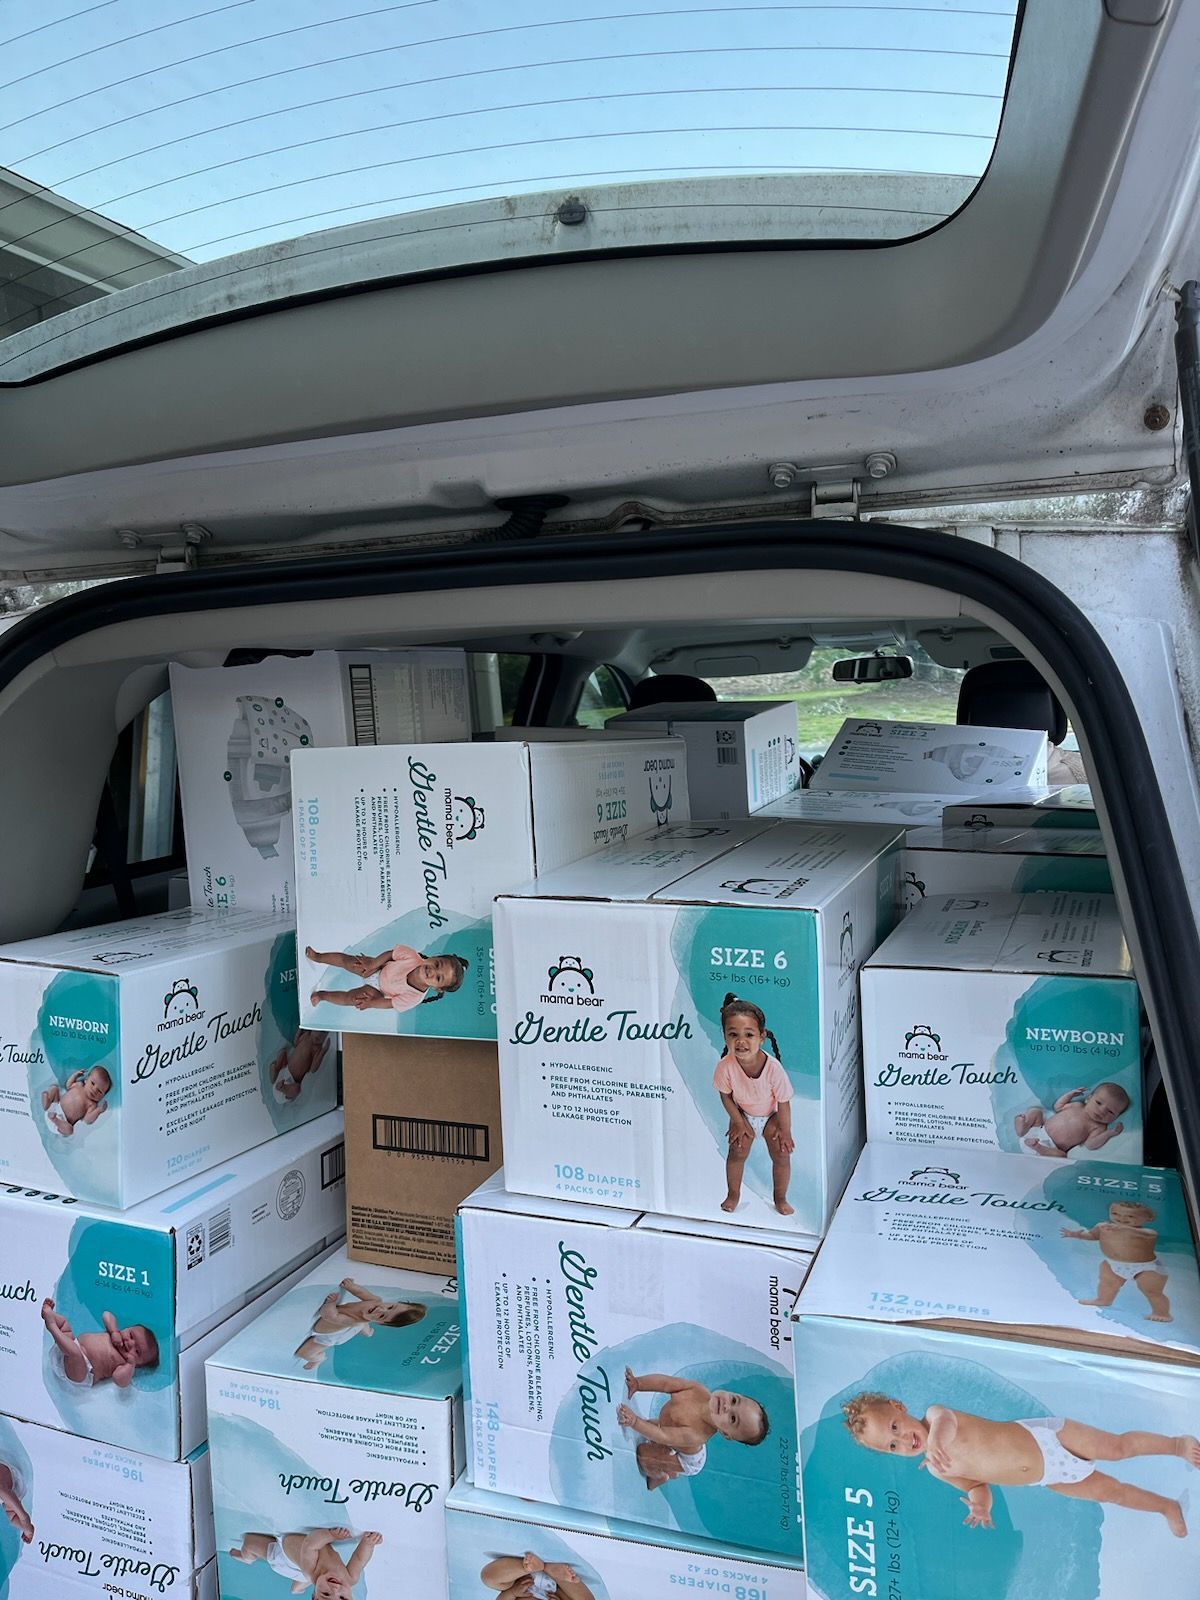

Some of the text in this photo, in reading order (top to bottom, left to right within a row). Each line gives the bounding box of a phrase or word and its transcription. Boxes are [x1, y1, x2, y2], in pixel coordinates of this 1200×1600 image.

[445, 788, 454, 850] mama bear
[597, 800, 627, 823] SIZE 6
[308, 797, 319, 877] 108 DIAPERS
[408, 756, 449, 929] Gentle Touch
[203, 866, 213, 897] Touch
[476, 946, 484, 963] 35+
[710, 946, 788, 970] SIZE 6
[709, 972, 791, 988] 35+ lbs (16+ kg)
[477, 1004, 485, 1016] kg)
[540, 994, 604, 1007] mama bear
[49, 1015, 110, 1034] NEWBORN
[157, 1010, 206, 1032] mama bear
[509, 1010, 693, 1045] Gentle Touch
[130, 1002, 262, 1084] Gentle Touch
[1025, 1027, 1125, 1046] NEWBORN
[4, 1044, 45, 1064] Touch
[898, 1051, 949, 1061] mama bear
[1030, 1044, 1121, 1057] up to 10 lbs (4 kg)
[549, 1062, 613, 1073] HYPOALLERGENIC
[874, 1063, 1018, 1087] Gentle Touch
[550, 1075, 674, 1093] FREE FROM CHLORINE BLEACHING,
[550, 1083, 667, 1100] PERFUMES, LOTIONS, PARABENS,
[568, 1092, 614, 1102] PHTHALATES
[894, 1101, 945, 1110] HYPOALLERGENIC
[552, 1112, 632, 1126] LEAKAGE PROTECTION
[583, 1107, 608, 1116] HOURS
[895, 1116, 926, 1124] PERFUMES,
[955, 1121, 988, 1129] PARABENS,
[167, 1154, 183, 1169] 120
[554, 1164, 641, 1188] 108 DIAPERS
[898, 1180, 970, 1191] mama bear
[1077, 1175, 1138, 1190] SIZE
[564, 1184, 594, 1194] PACKS
[597, 1188, 610, 1196] OF
[612, 1190, 623, 1198] 27
[853, 1187, 968, 1206] Gentle
[970, 1192, 1067, 1214] Touch
[98, 1261, 150, 1286] SIZE 1
[769, 1275, 782, 1351] mama bear
[870, 1292, 991, 1316] 132 DIAPERS
[880, 1305, 923, 1316] PACKS
[494, 1281, 504, 1370] LEAKAGE PROTECTION
[502, 1283, 511, 1359] UP TO 12 HOURS OF
[546, 1288, 555, 1360] HYPOALLERGENIC
[430, 1324, 460, 1354] SIZE
[420, 1355, 441, 1365] 2
[558, 1240, 613, 1462] Gentle Touch
[219, 1389, 280, 1410] 184 DIAPERS
[527, 1369, 535, 1413] PARABENS,
[535, 1375, 543, 1422] BLEACHING,
[475, 1407, 483, 1437] PACKS
[476, 1440, 484, 1455] OF
[486, 1401, 500, 1489] 148 DIAPERS
[122, 1467, 144, 1482] 196
[780, 1437, 791, 1531] 22-37 lbs (10-17 kg)
[278, 1473, 439, 1513] Gentle Touch
[845, 1487, 878, 1598] SIZE 5
[885, 1490, 902, 1600] 27+ lbs (12+ kg)
[39, 1541, 180, 1593] Gentle Touch
[687, 1564, 769, 1585] 4 PACKS OF 42
[102, 1583, 124, 1597] bear
[670, 1573, 767, 1600] 168 DIAPERS
